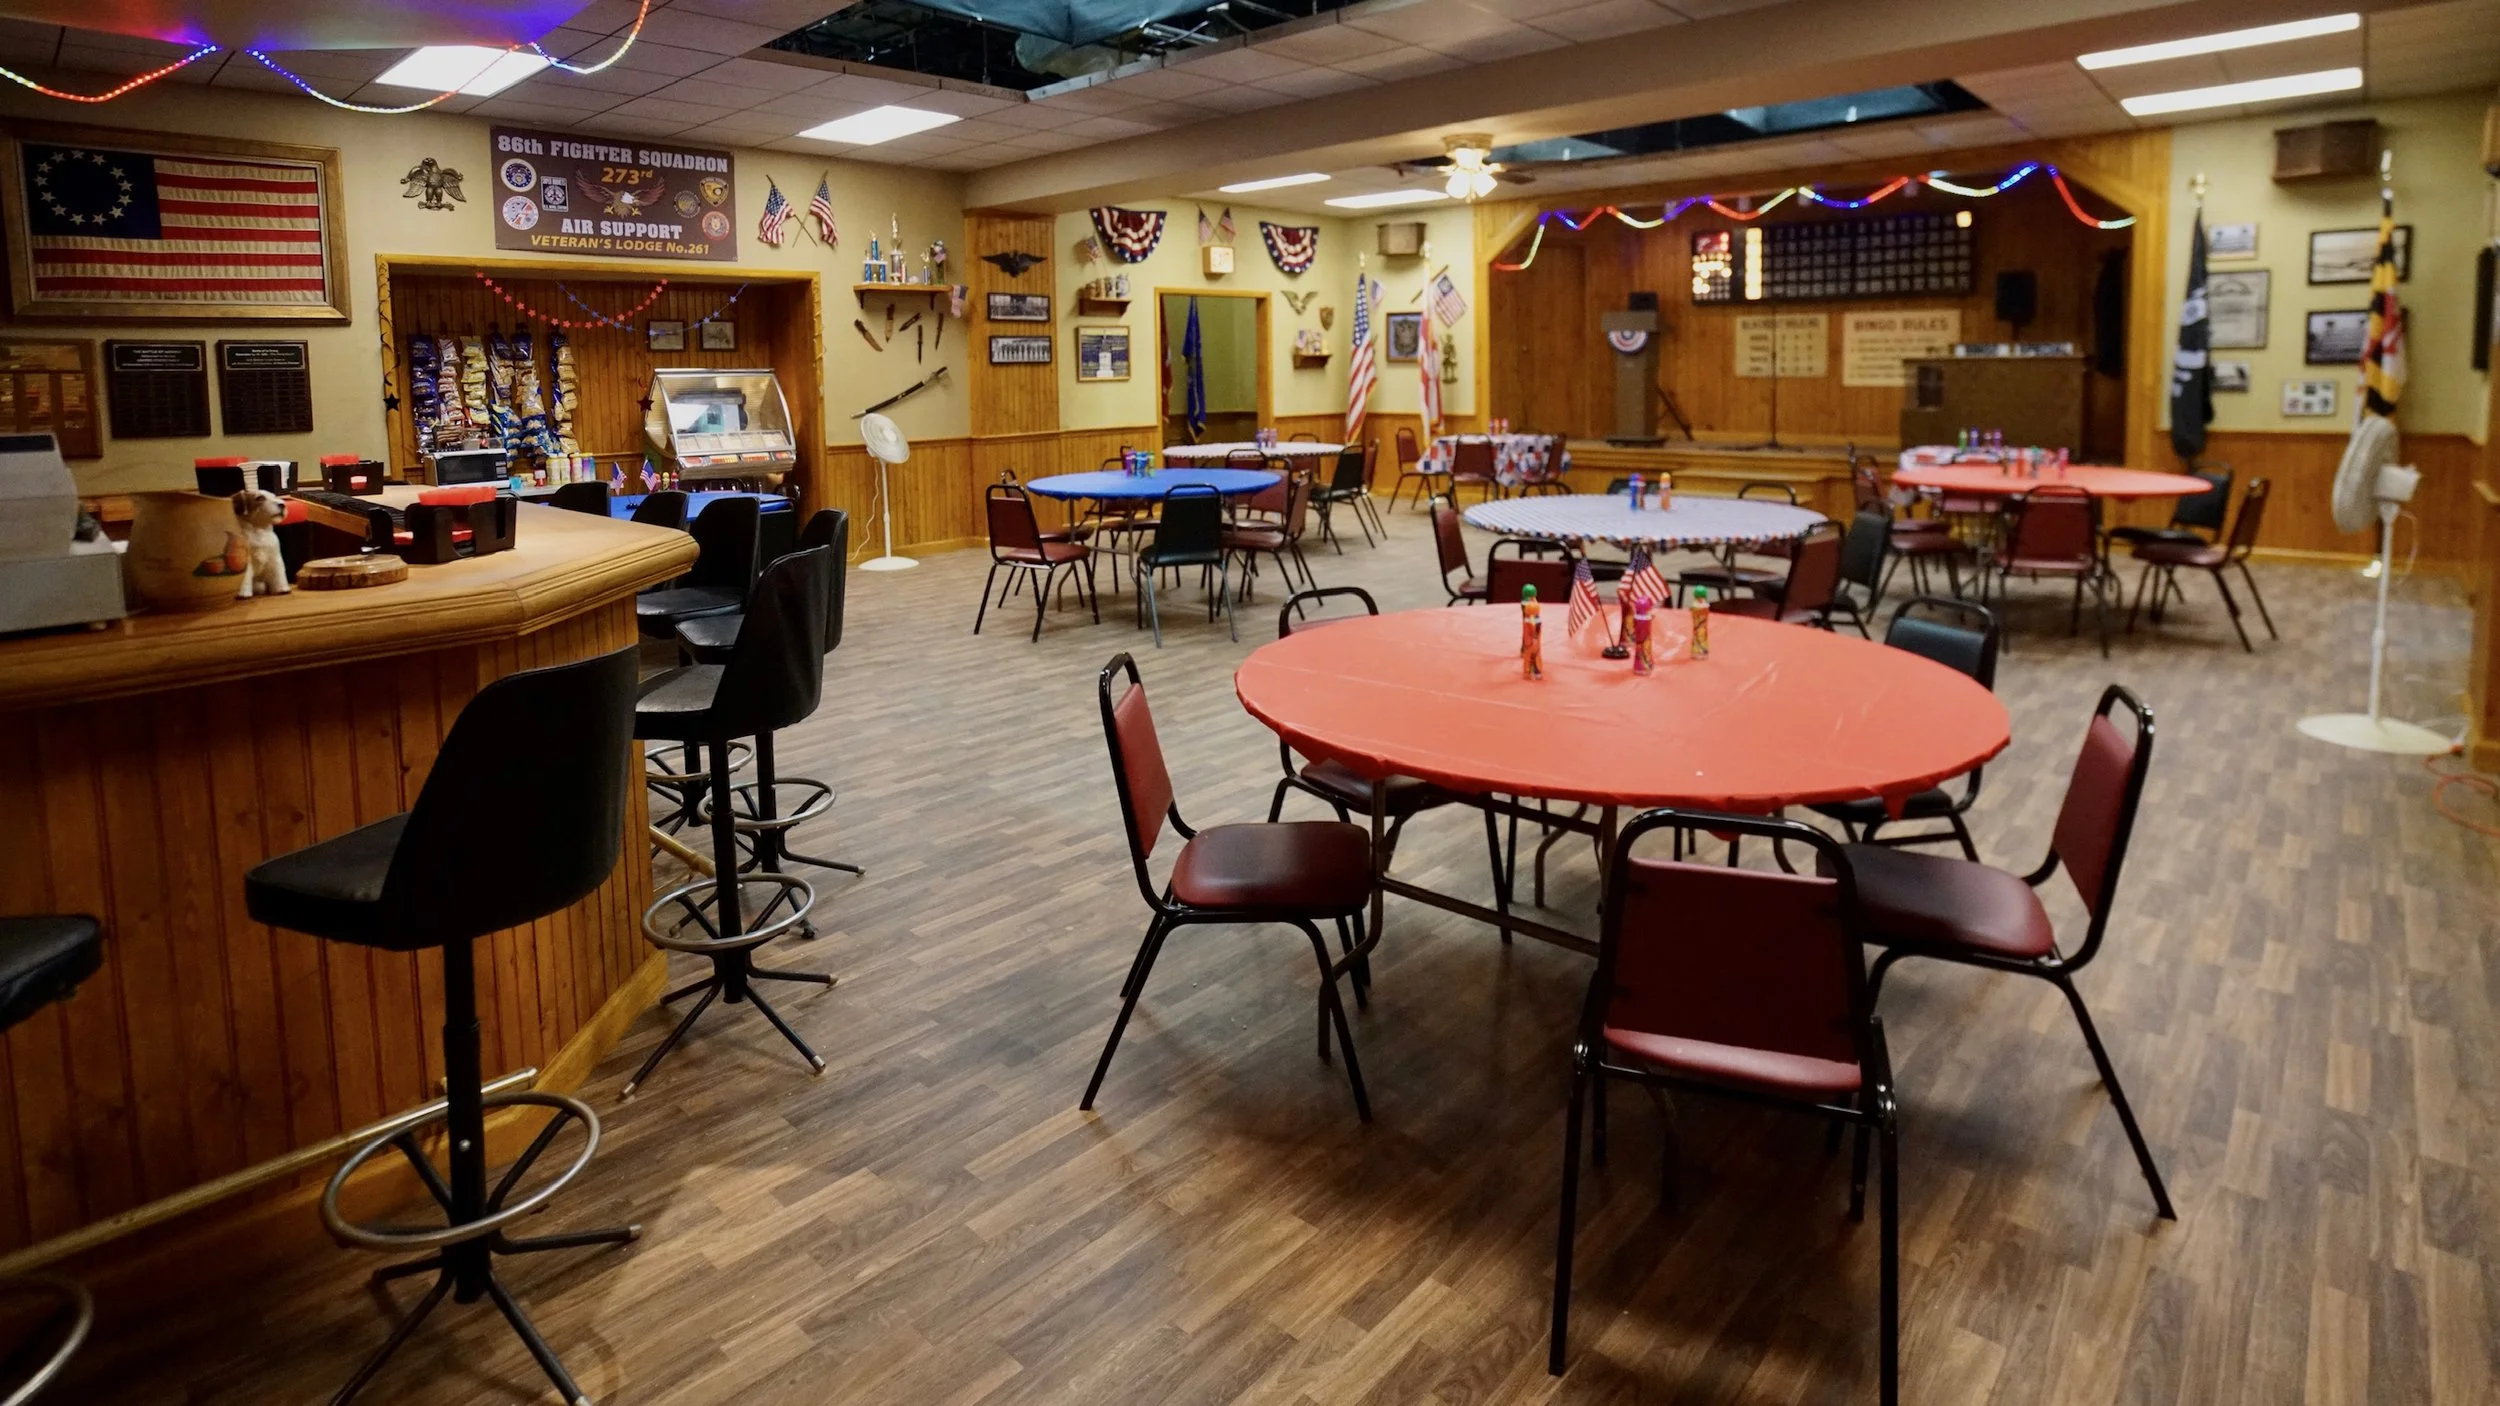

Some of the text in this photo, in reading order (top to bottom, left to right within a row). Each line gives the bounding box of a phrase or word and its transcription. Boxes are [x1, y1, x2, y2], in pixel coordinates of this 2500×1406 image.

[497, 135, 728, 172] 86th FIGHTER SQUADRON
[601, 167, 653, 185] 273rd
[561, 218, 682, 240] AIR SUPPORT
[531, 235, 709, 255] VETERAN'S LODGE No.261
